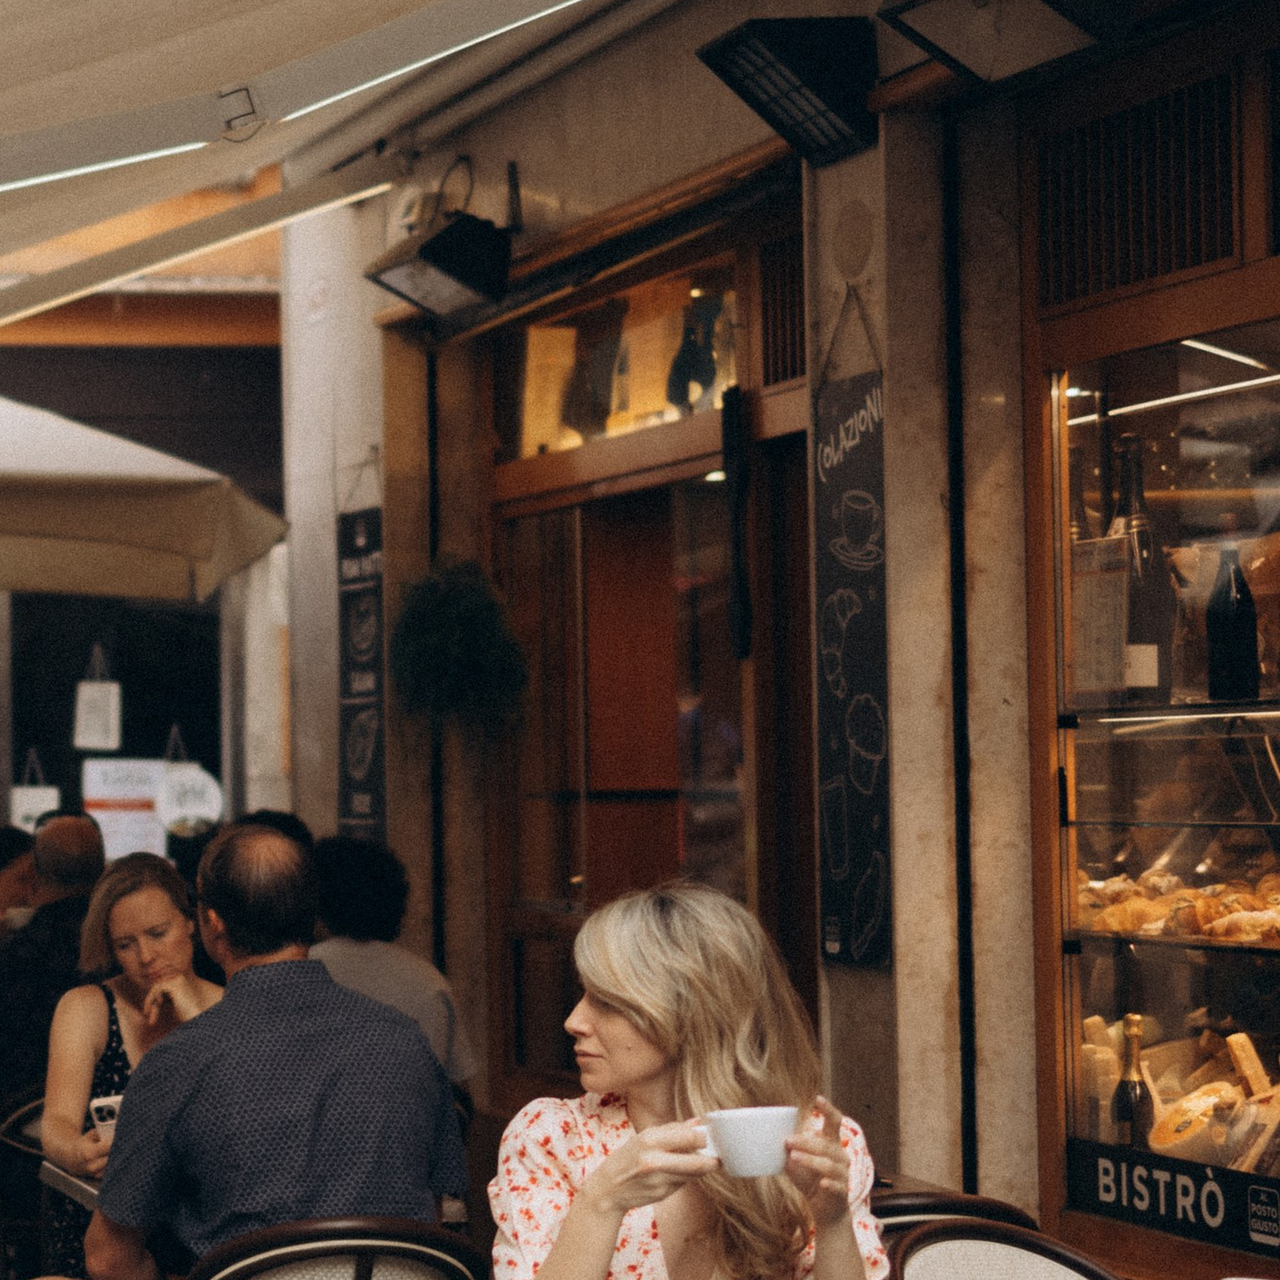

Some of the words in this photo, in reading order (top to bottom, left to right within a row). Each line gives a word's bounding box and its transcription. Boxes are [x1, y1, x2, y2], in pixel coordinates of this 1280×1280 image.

[817, 387, 883, 484] COLAZIONI
[1097, 1157, 1225, 1228] BISTRÒ
[1250, 1203, 1278, 1219] POSTO
[1251, 1219, 1278, 1234] GIUSTO
